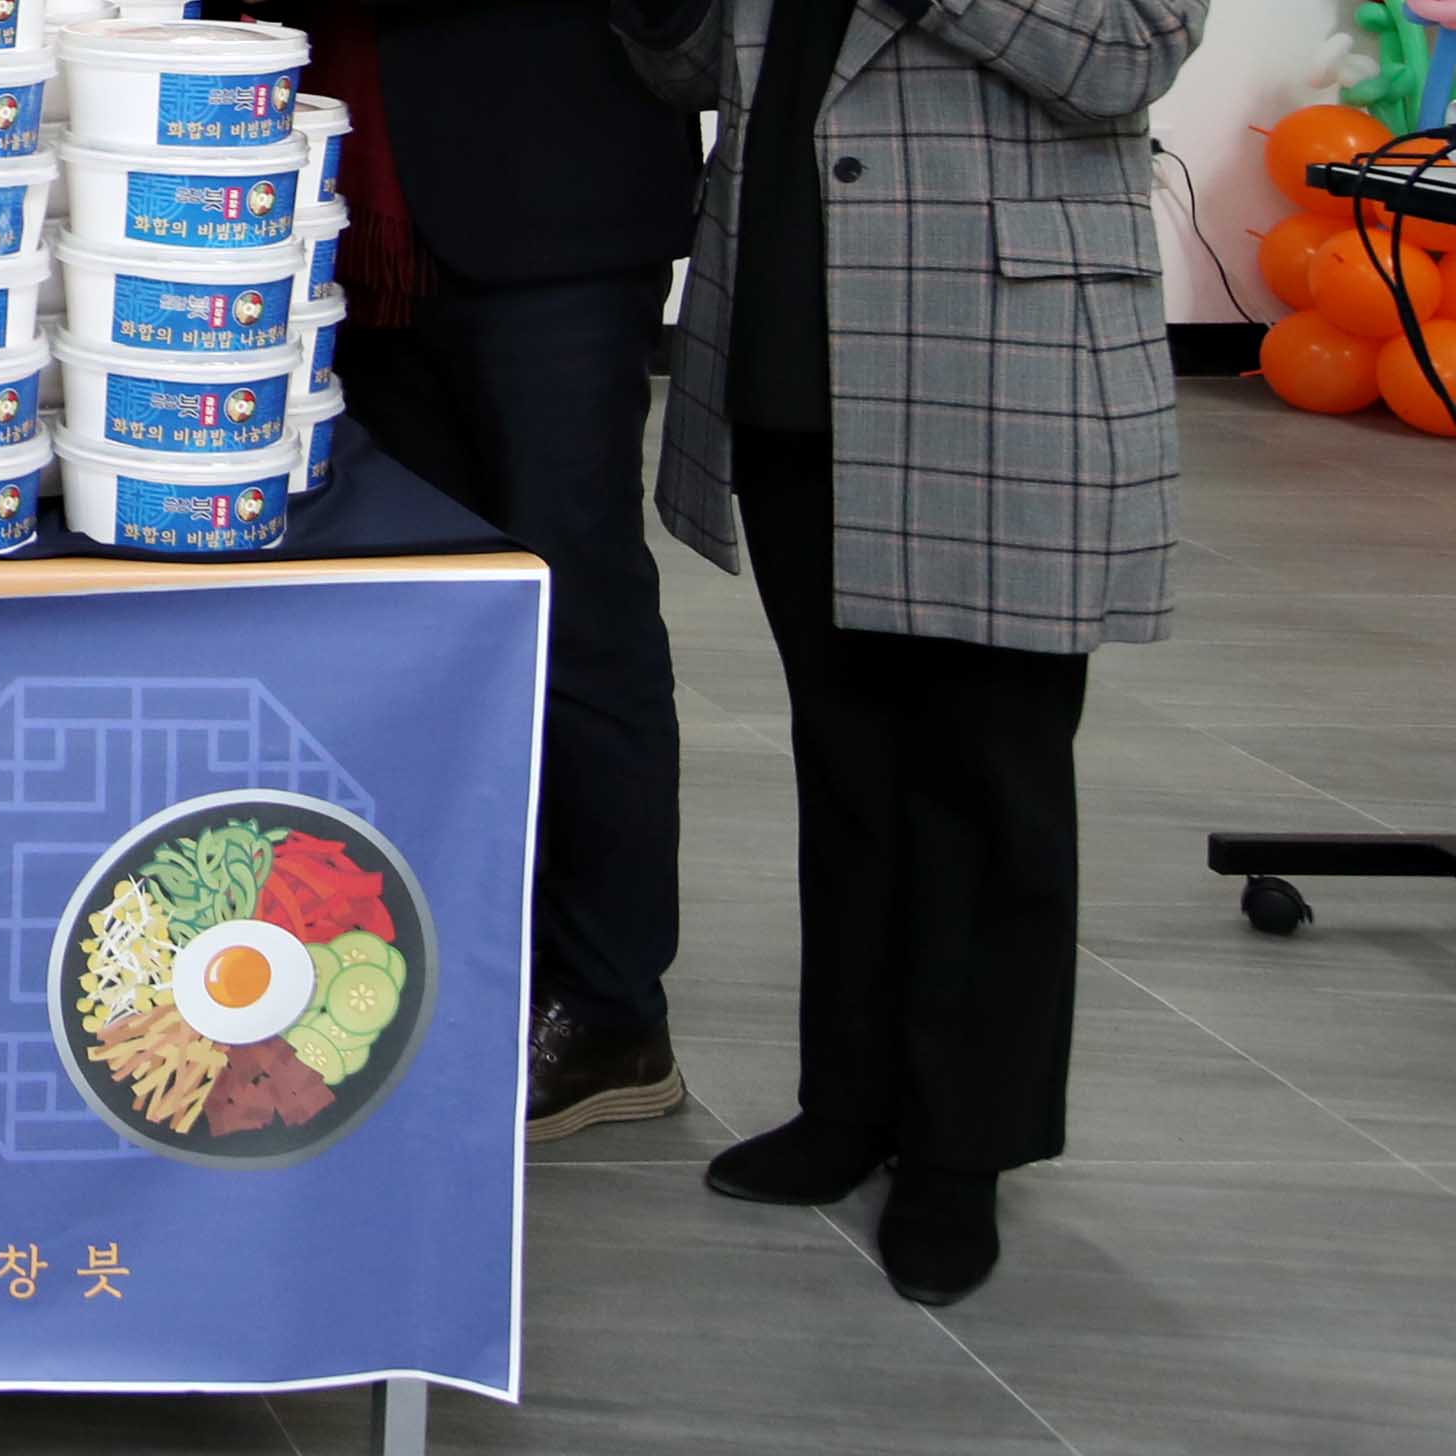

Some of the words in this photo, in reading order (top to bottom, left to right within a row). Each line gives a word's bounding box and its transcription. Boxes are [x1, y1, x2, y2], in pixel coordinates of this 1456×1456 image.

[167, 122, 221, 139] 화합의
[134, 216, 187, 238] 화합의
[198, 223, 247, 239] 비빔밥
[120, 321, 172, 343] 화합의
[183, 330, 233, 348] 비빔밥
[112, 418, 163, 441] 화합의
[174, 428, 225, 446] 비빔밥
[124, 524, 177, 545] 화합의
[188, 531, 237, 549] 비빔밥
